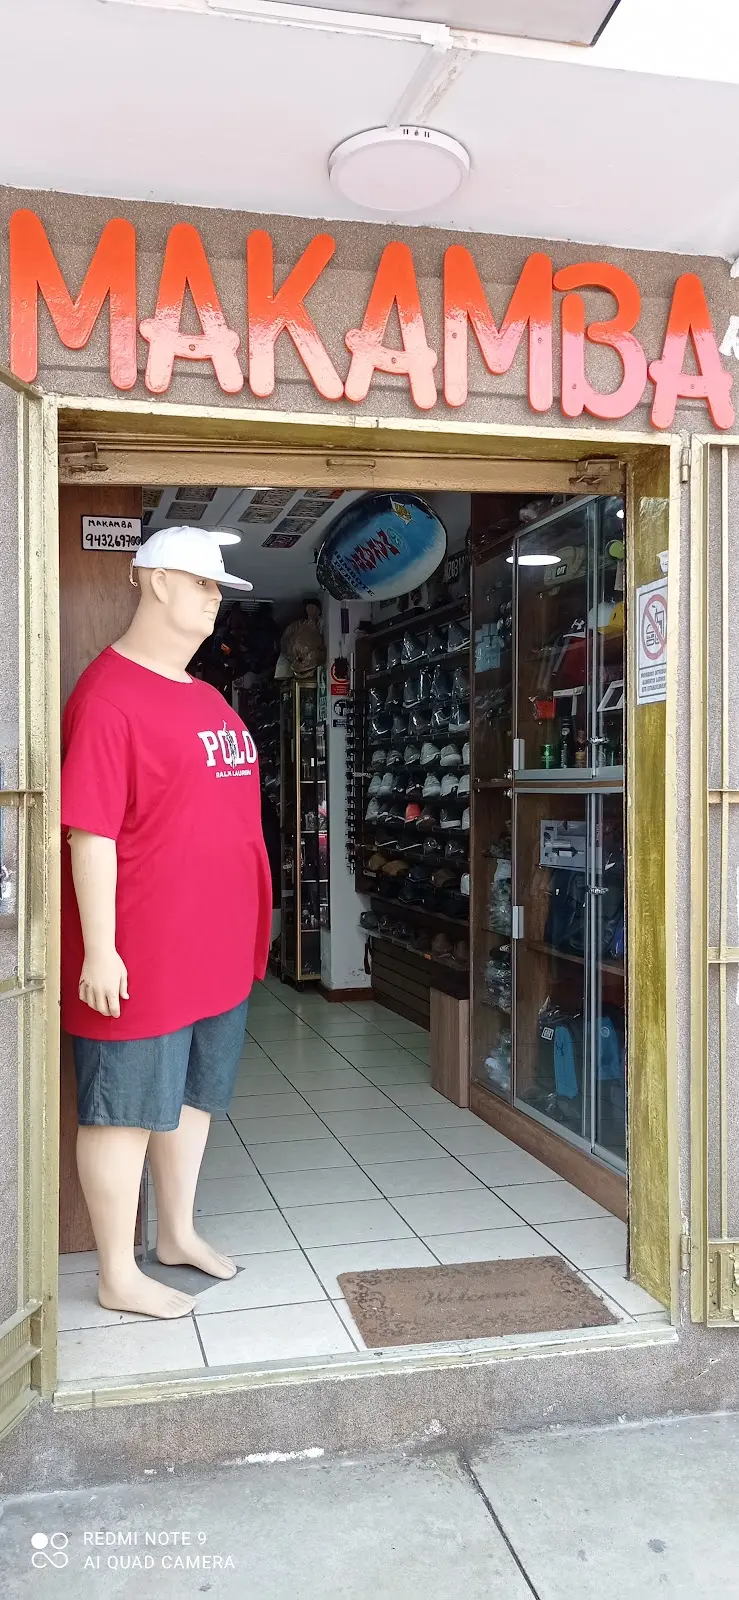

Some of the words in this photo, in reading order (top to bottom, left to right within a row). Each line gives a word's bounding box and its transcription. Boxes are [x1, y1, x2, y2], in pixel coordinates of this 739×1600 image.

[9, 208, 734, 430] MAKAMBA
[88, 519, 133, 529] MAKAMBA
[196, 729, 257, 767] POLO
[233, 769, 252, 777] LAUREN
